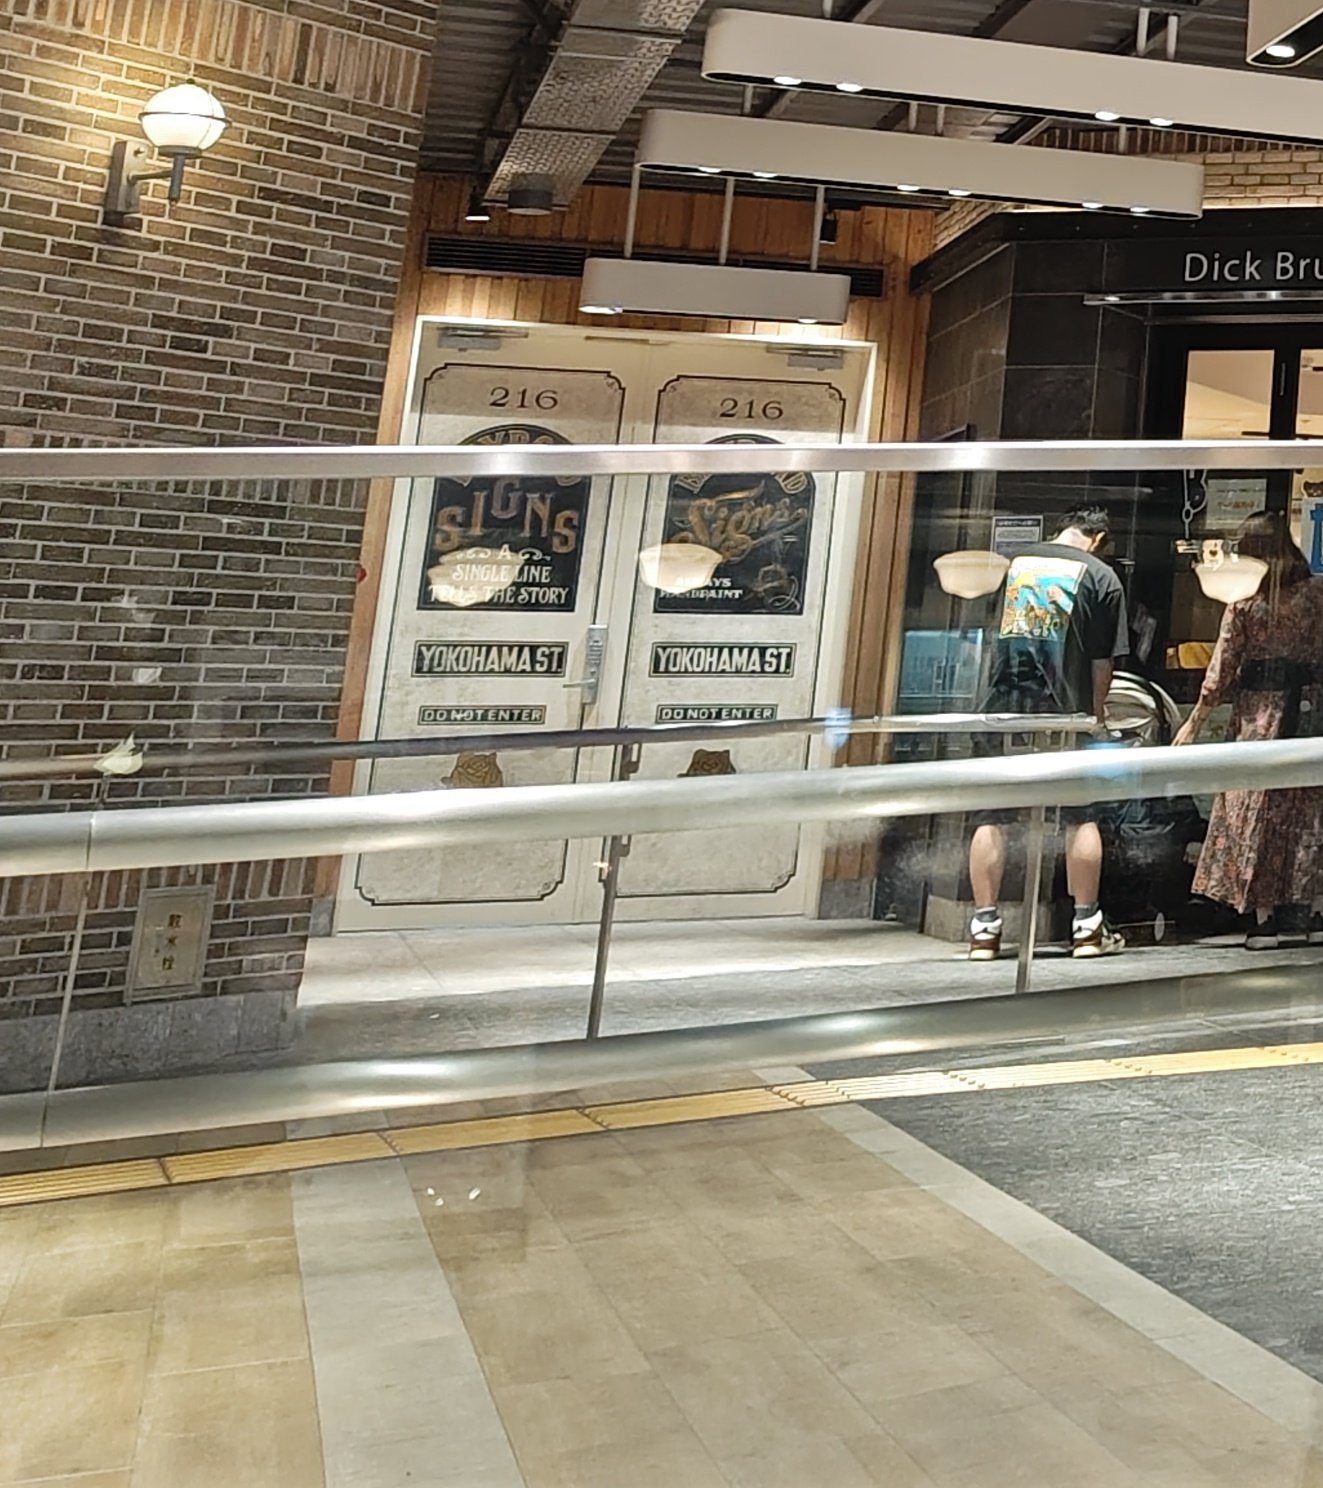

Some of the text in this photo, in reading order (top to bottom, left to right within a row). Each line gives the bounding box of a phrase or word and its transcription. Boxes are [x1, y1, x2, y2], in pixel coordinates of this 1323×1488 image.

[1184, 250, 1262, 282] Dick
[488, 386, 559, 410] 216
[719, 397, 784, 420] 216
[434, 476, 580, 553] SIGNS
[497, 544, 512, 560] A
[451, 563, 552, 583] SINGLE LINE
[483, 586, 515, 604] THE
[517, 587, 569, 606] STORY
[420, 645, 564, 674] YOKOHAMA ST.
[657, 646, 791, 674] YOKOHAMA ST.
[487, 709, 541, 722] ENTER
[722, 707, 772, 720] ENTER
